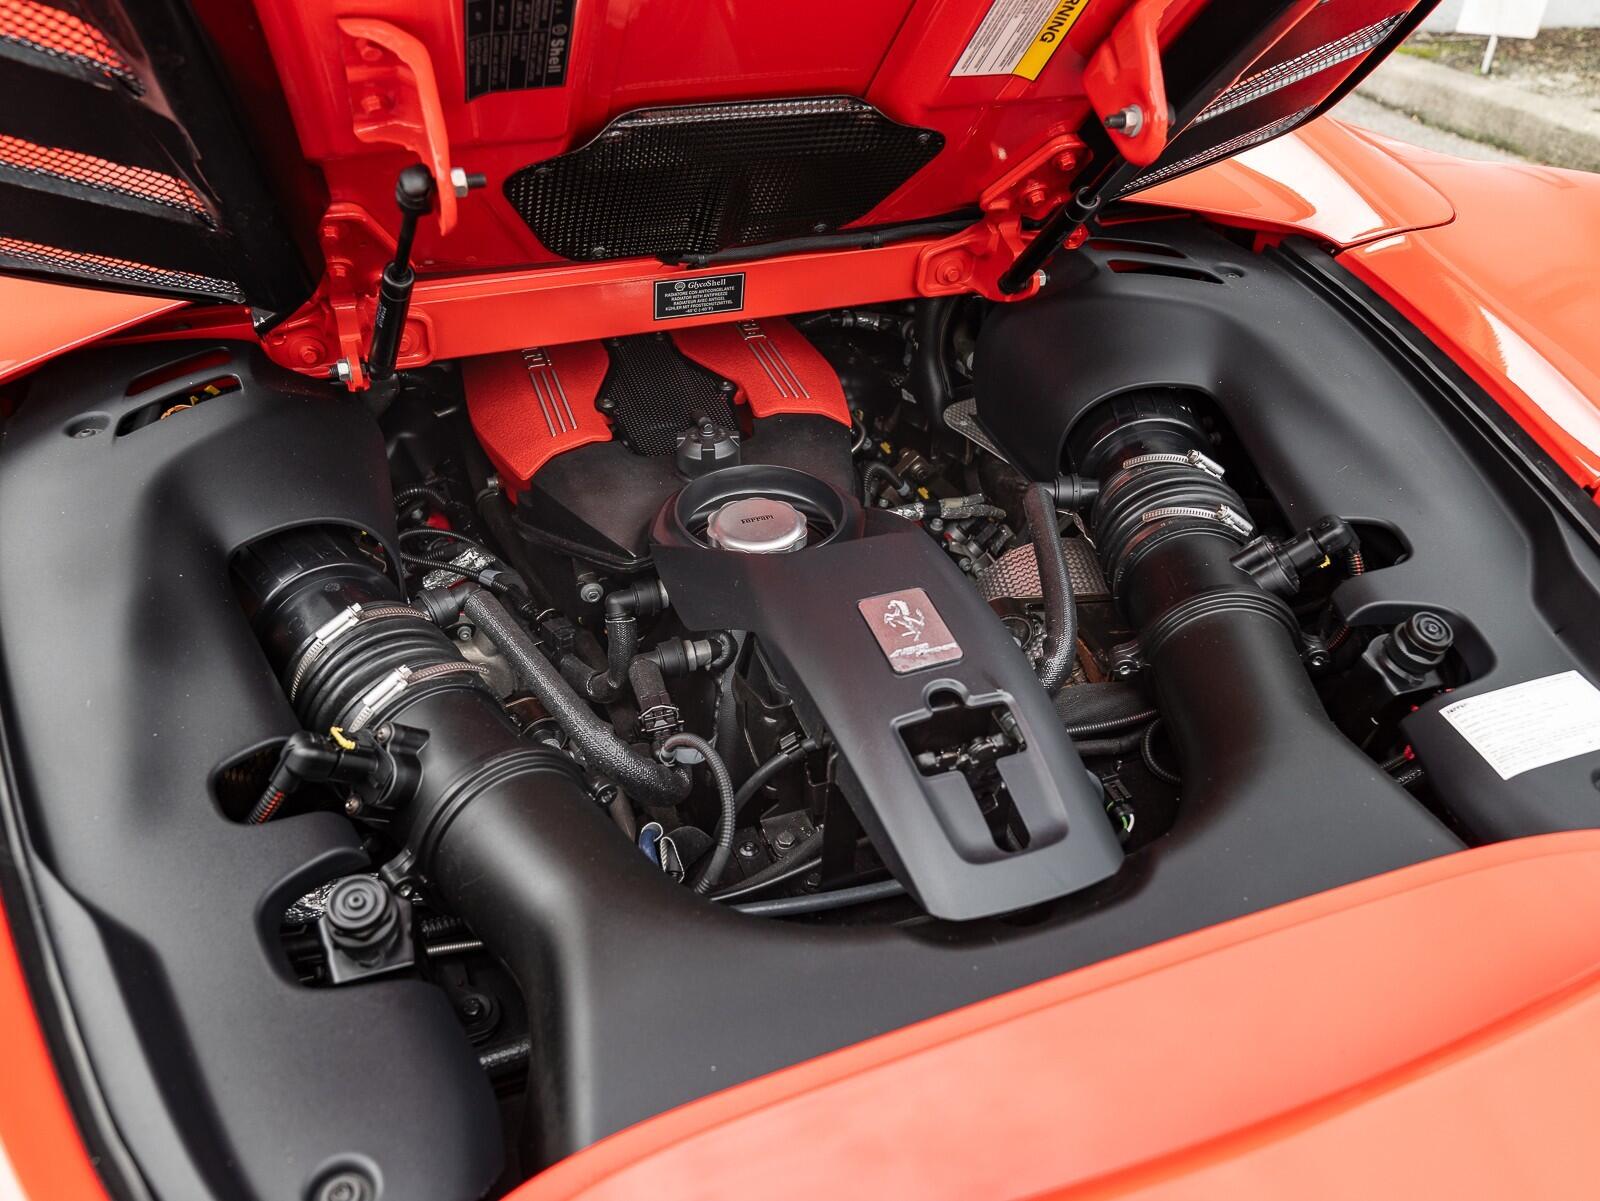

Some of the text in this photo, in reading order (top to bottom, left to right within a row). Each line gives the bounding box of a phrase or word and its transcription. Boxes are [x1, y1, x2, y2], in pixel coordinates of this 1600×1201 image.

[548, 38, 564, 73] Shell
[688, 278, 726, 289] GlycoShell
[698, 286, 735, 294] ANTICONGELANTE
[740, 514, 775, 524] Ferrari
